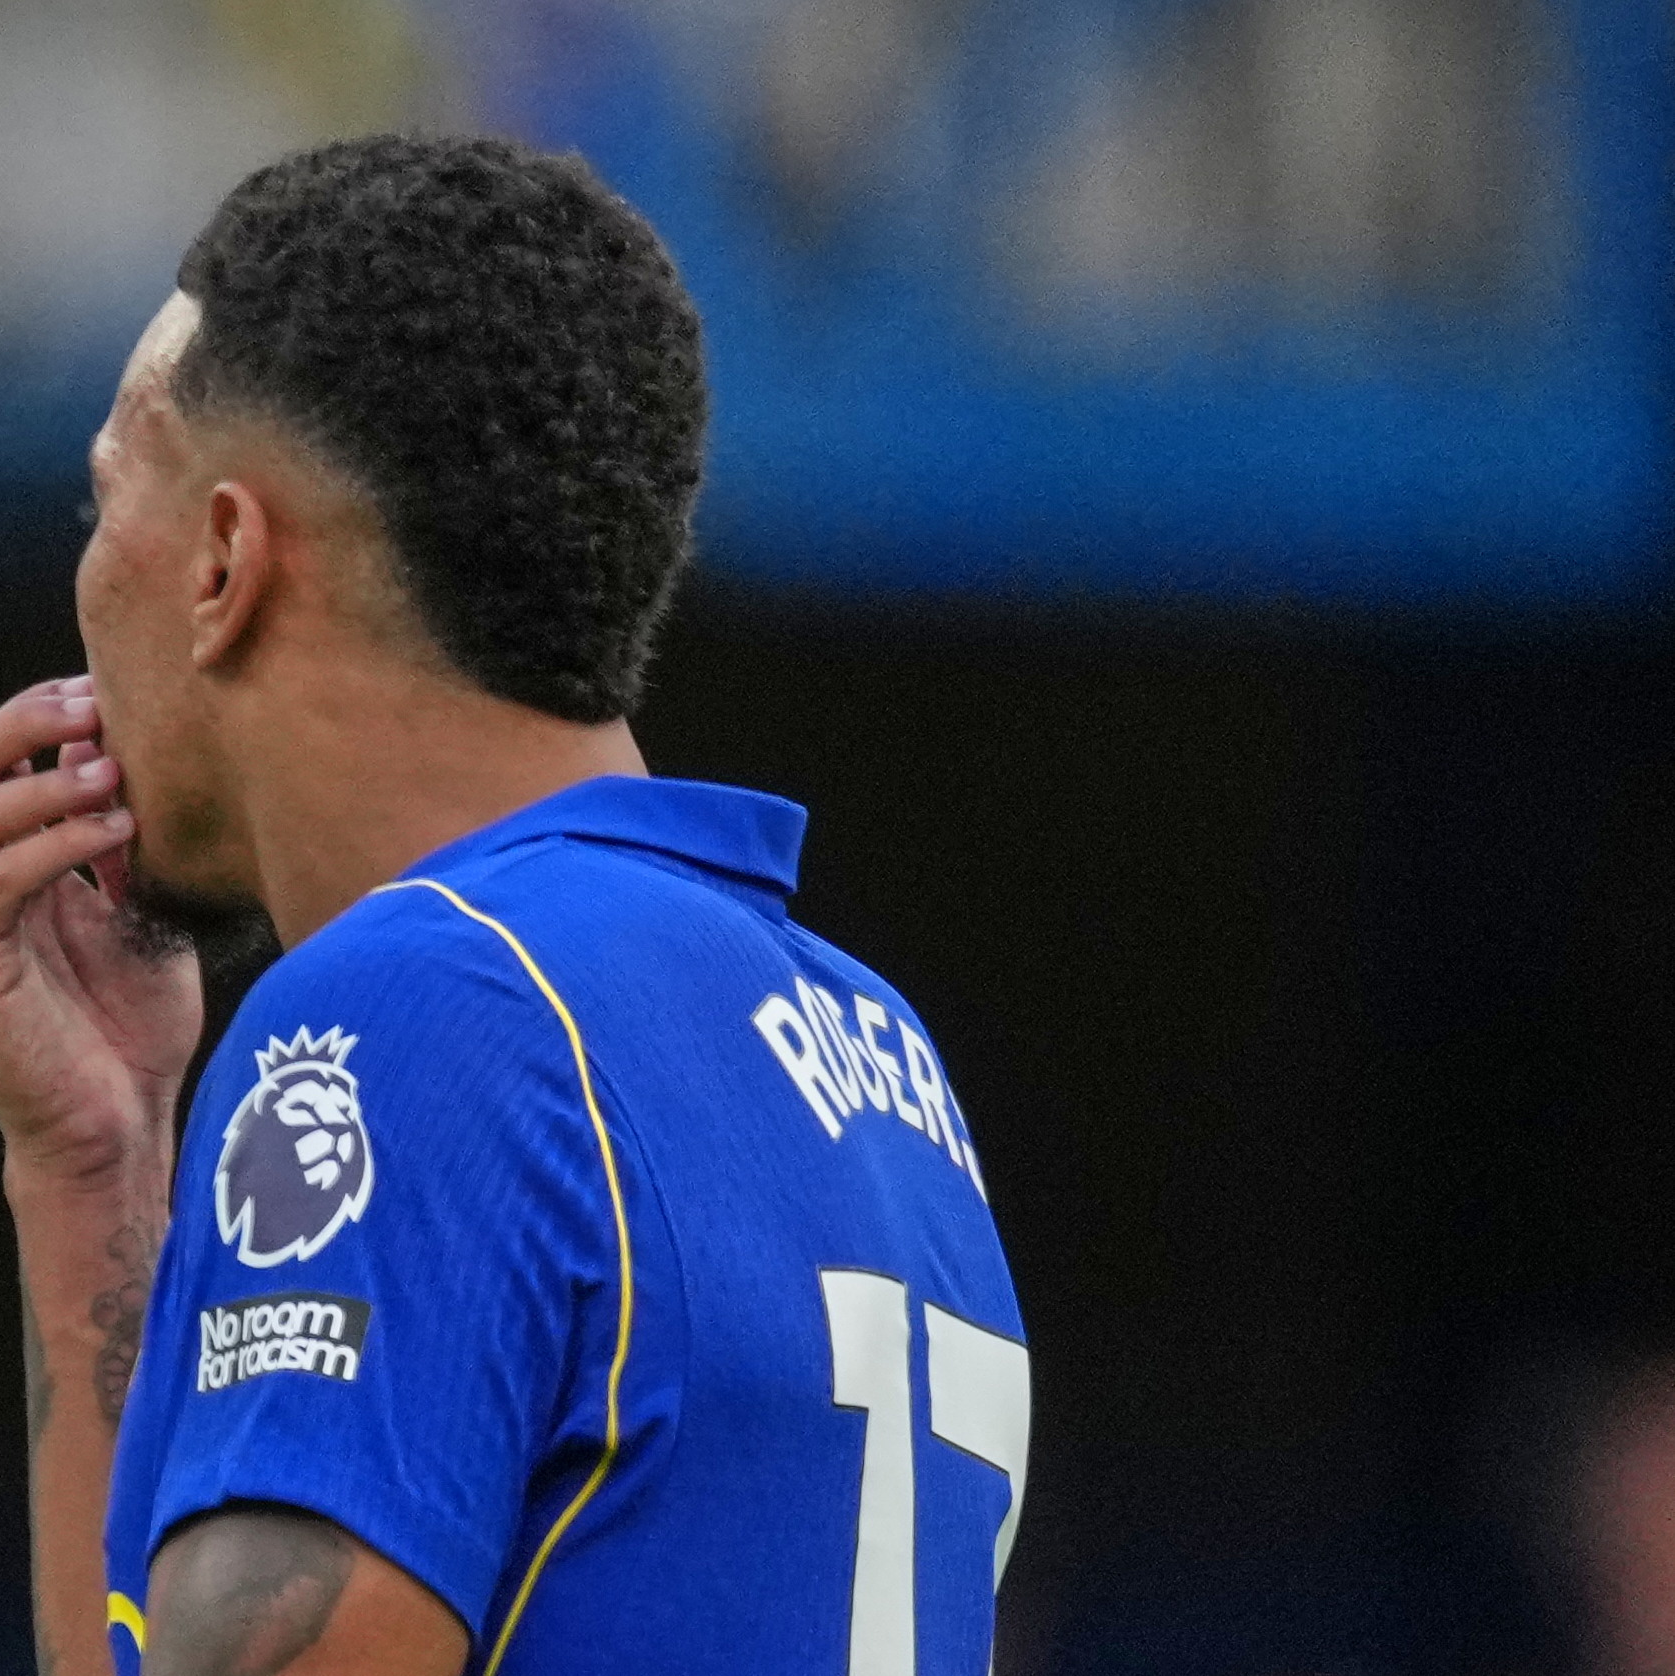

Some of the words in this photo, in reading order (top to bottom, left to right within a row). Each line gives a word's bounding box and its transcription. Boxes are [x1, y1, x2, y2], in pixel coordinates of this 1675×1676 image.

[200, 1306, 241, 1350] No
[242, 1301, 345, 1341] room
[197, 1350, 236, 1392] for
[237, 1337, 359, 1382] racism
